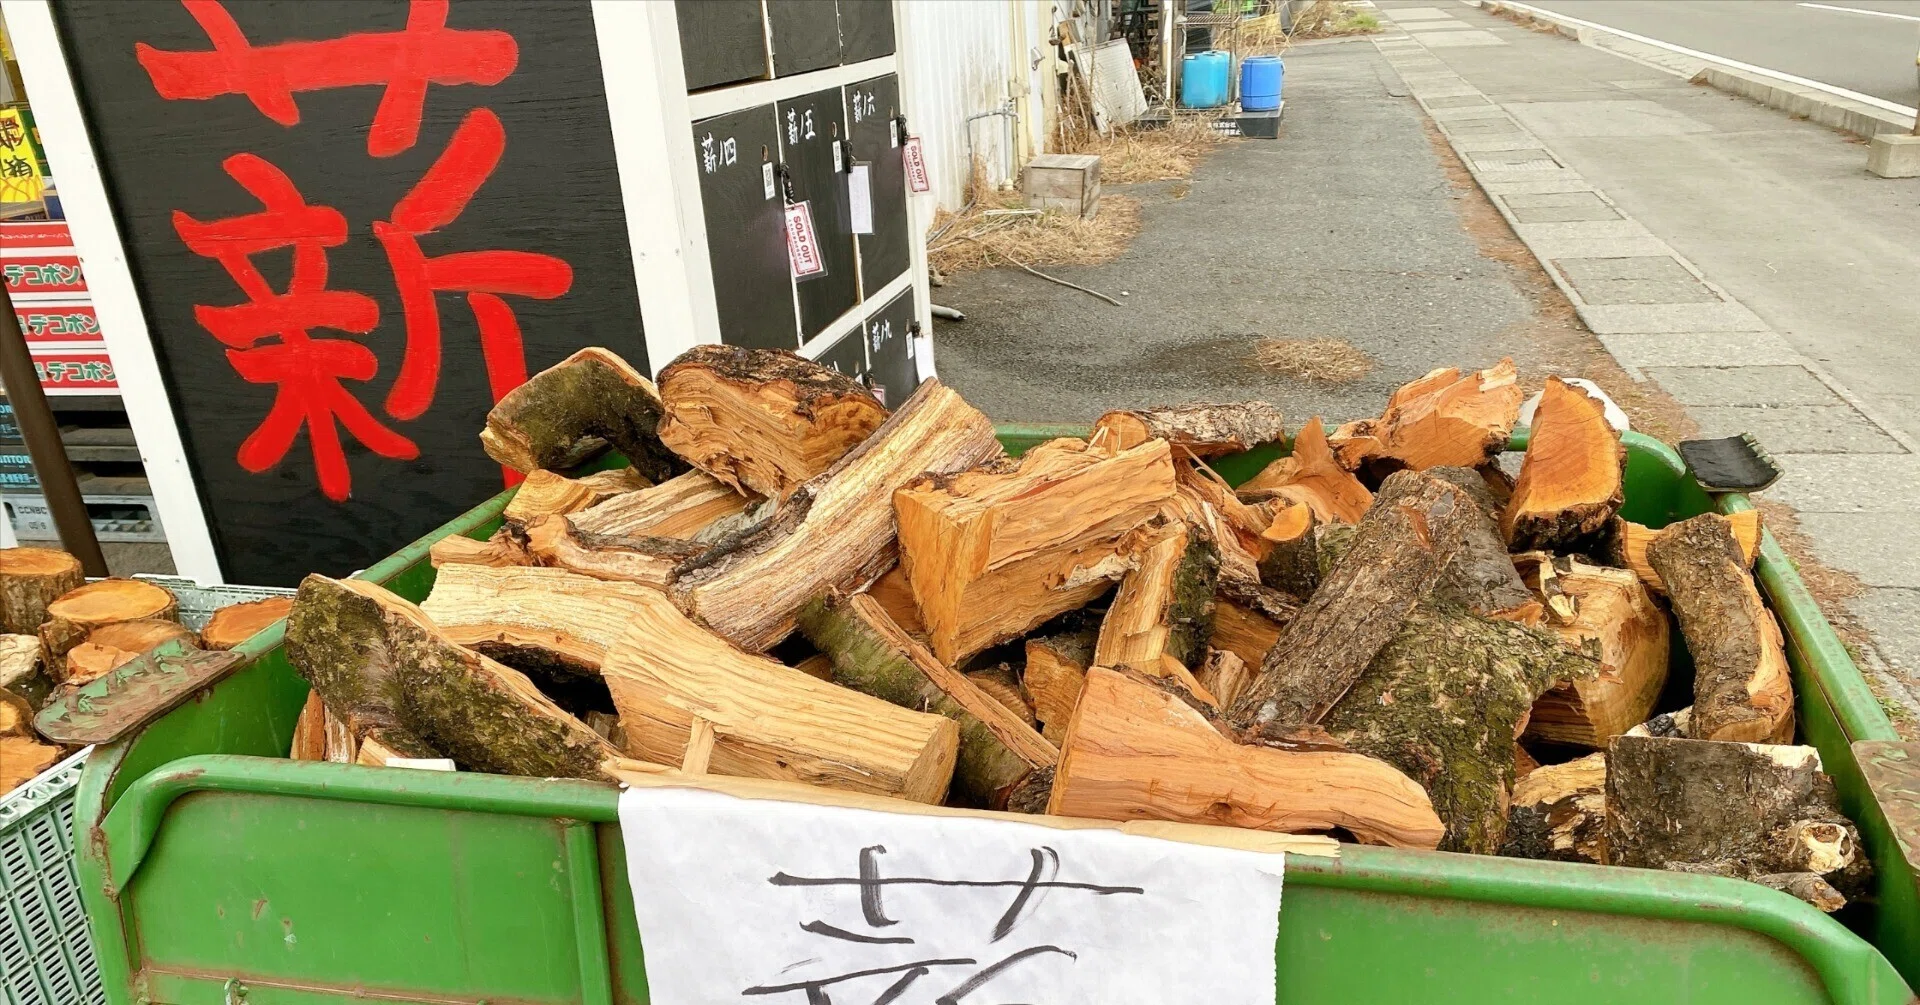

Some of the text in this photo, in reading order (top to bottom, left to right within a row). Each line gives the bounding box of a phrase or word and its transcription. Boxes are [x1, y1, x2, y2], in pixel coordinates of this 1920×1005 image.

[911, 145, 920, 167] SOLD
[916, 168, 925, 184] OUT
[135, 0, 573, 502] 薪
[793, 215, 807, 243] SOLD
[801, 245, 812, 263] OUT
[4, 264, 80, 286] デコポン
